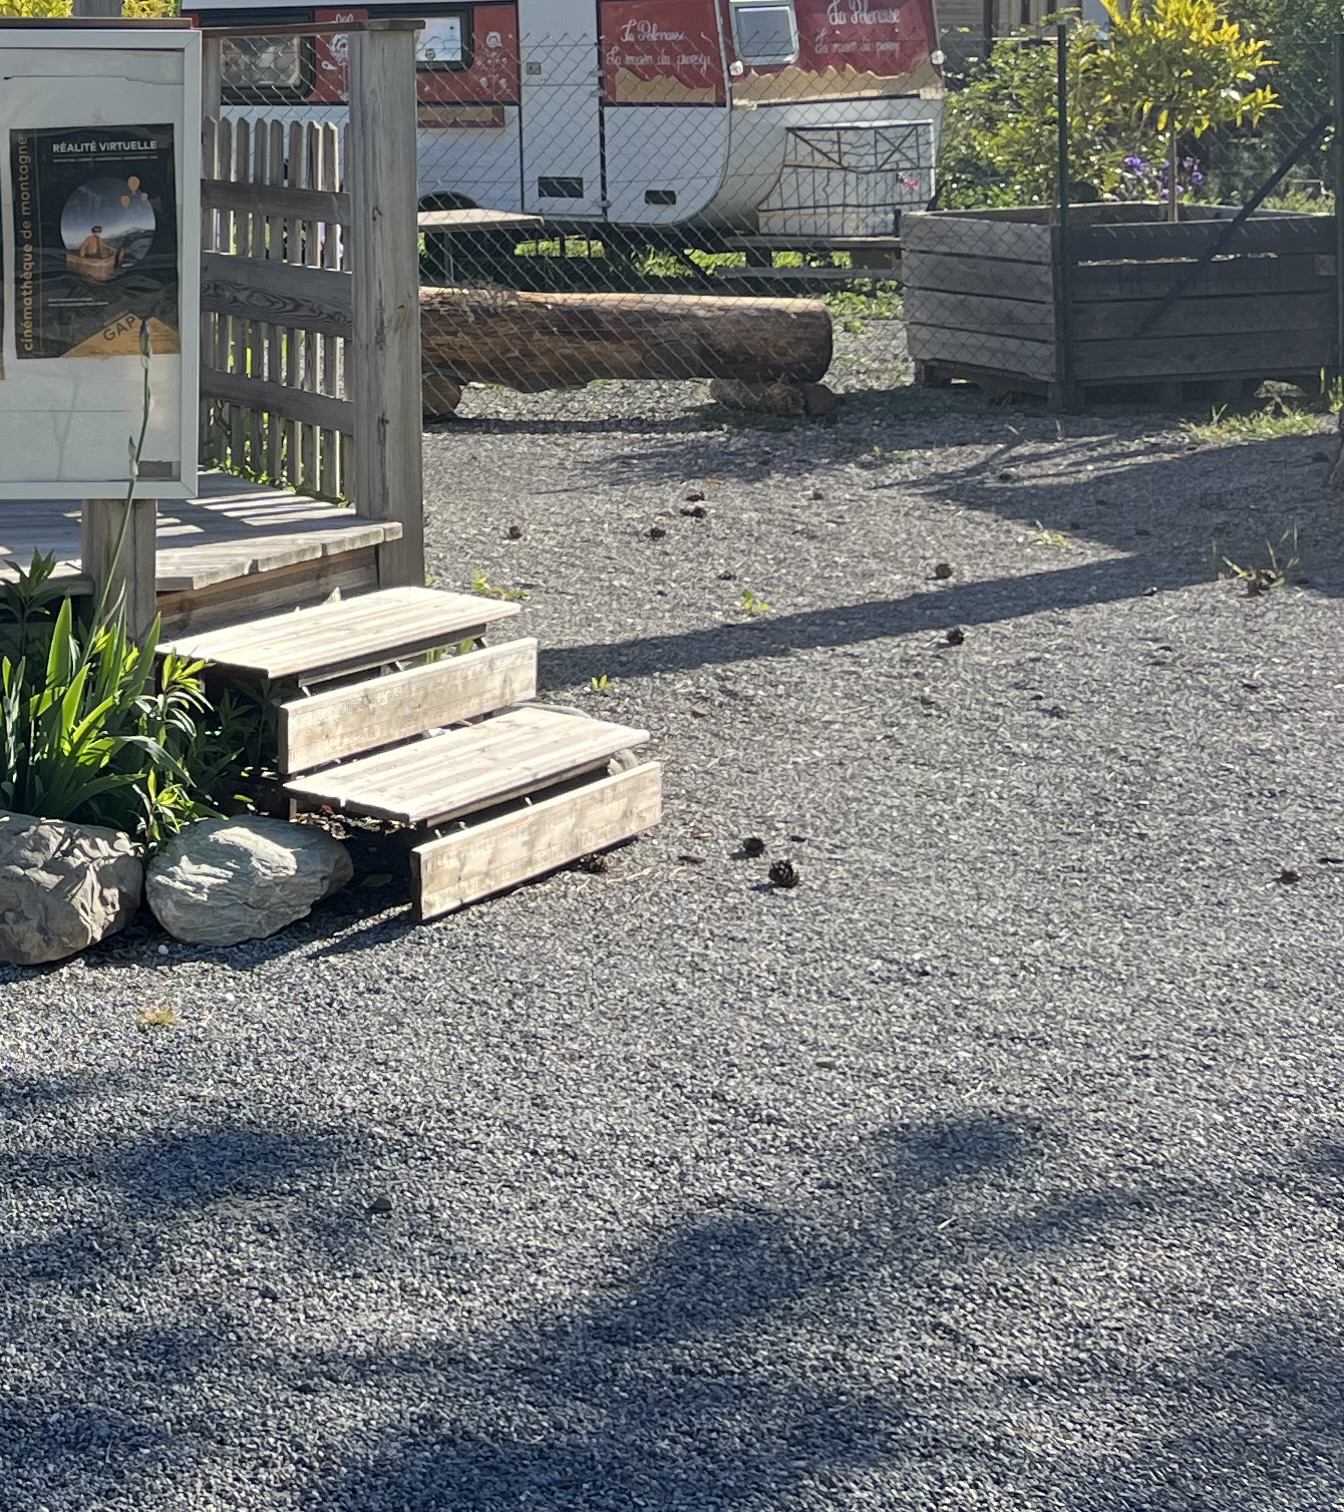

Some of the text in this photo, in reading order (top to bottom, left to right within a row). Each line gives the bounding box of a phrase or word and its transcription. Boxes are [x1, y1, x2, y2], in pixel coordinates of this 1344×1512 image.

[52, 139, 158, 153] RÉALITÉ VIRTUELLE
[16, 135, 35, 352] cinémathèque de montagne
[102, 315, 136, 342] GAP
